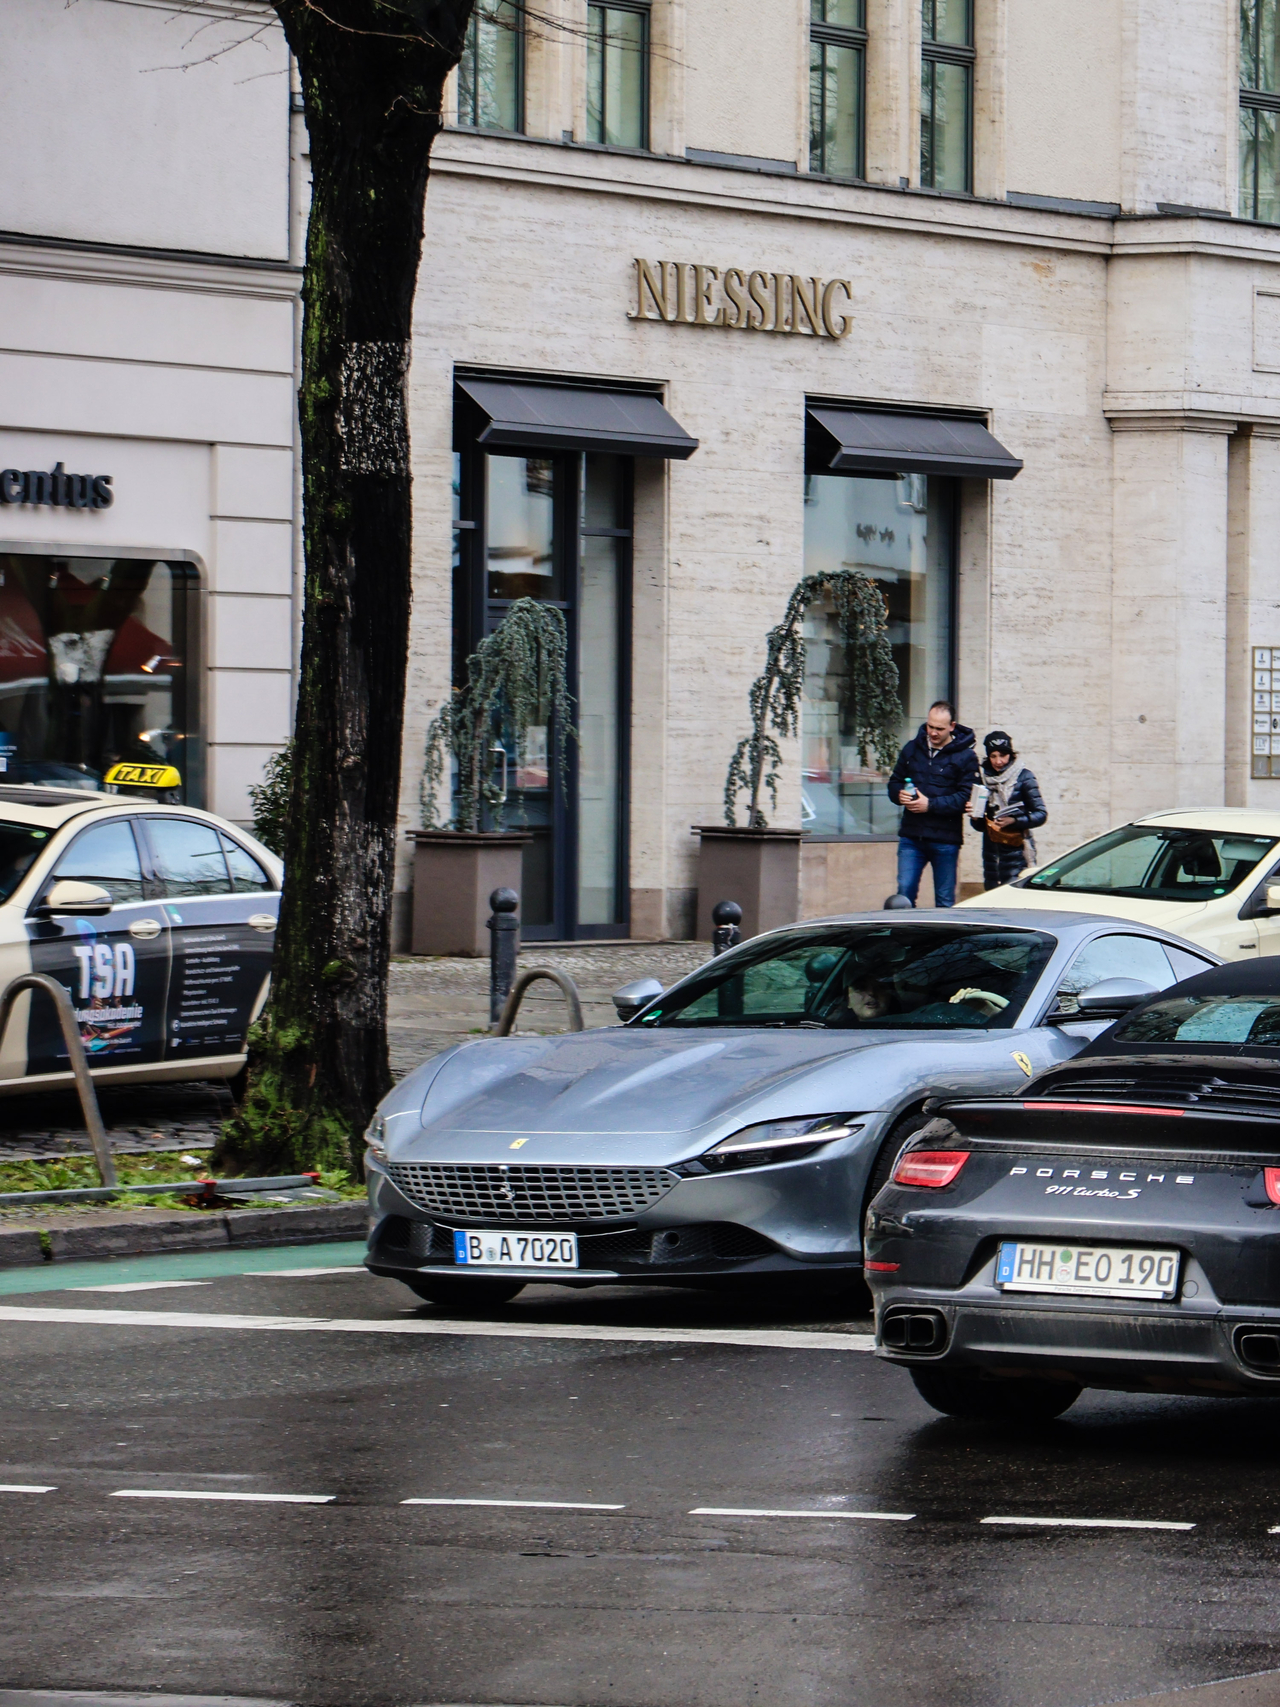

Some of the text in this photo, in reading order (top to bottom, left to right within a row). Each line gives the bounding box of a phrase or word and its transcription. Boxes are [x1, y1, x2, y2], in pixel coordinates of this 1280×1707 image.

[634, 258, 856, 339] NIESSING
[0, 461, 114, 509] entus
[117, 766, 165, 783] TAXI
[73, 943, 136, 999] TSA
[1009, 1166, 1195, 1185] PORSCHE
[1045, 1184, 1142, 1200] 911 turbo S
[469, 1236, 483, 1261] B
[1017, 1248, 1056, 1280] HH
[1118, 1253, 1174, 1286] 190
